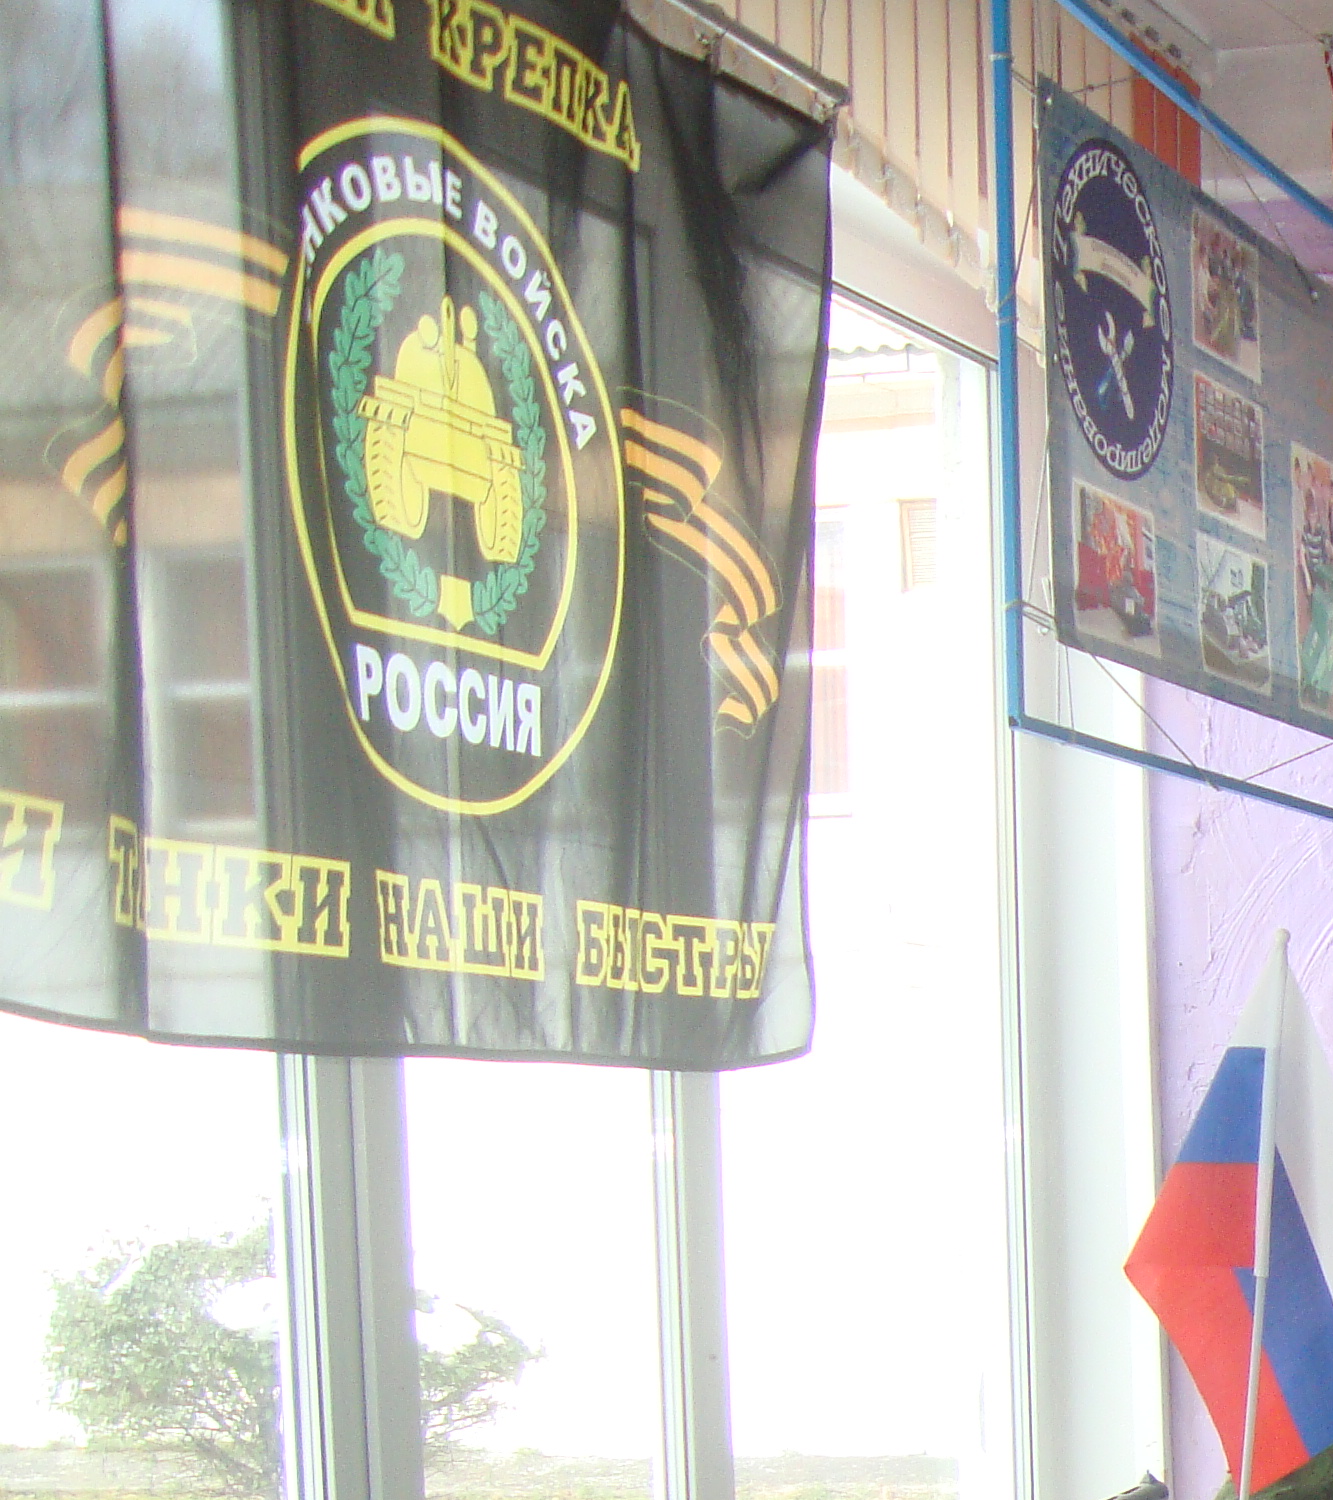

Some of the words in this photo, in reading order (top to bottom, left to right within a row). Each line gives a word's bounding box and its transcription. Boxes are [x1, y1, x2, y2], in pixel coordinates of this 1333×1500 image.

[428, 0, 641, 172] КРЕПКА
[472, 198, 599, 452] ВОЙСКА
[356, 642, 544, 758] РОССИЯ
[108, 813, 352, 958] ТНКИ
[374, 868, 545, 982] НАШИ
